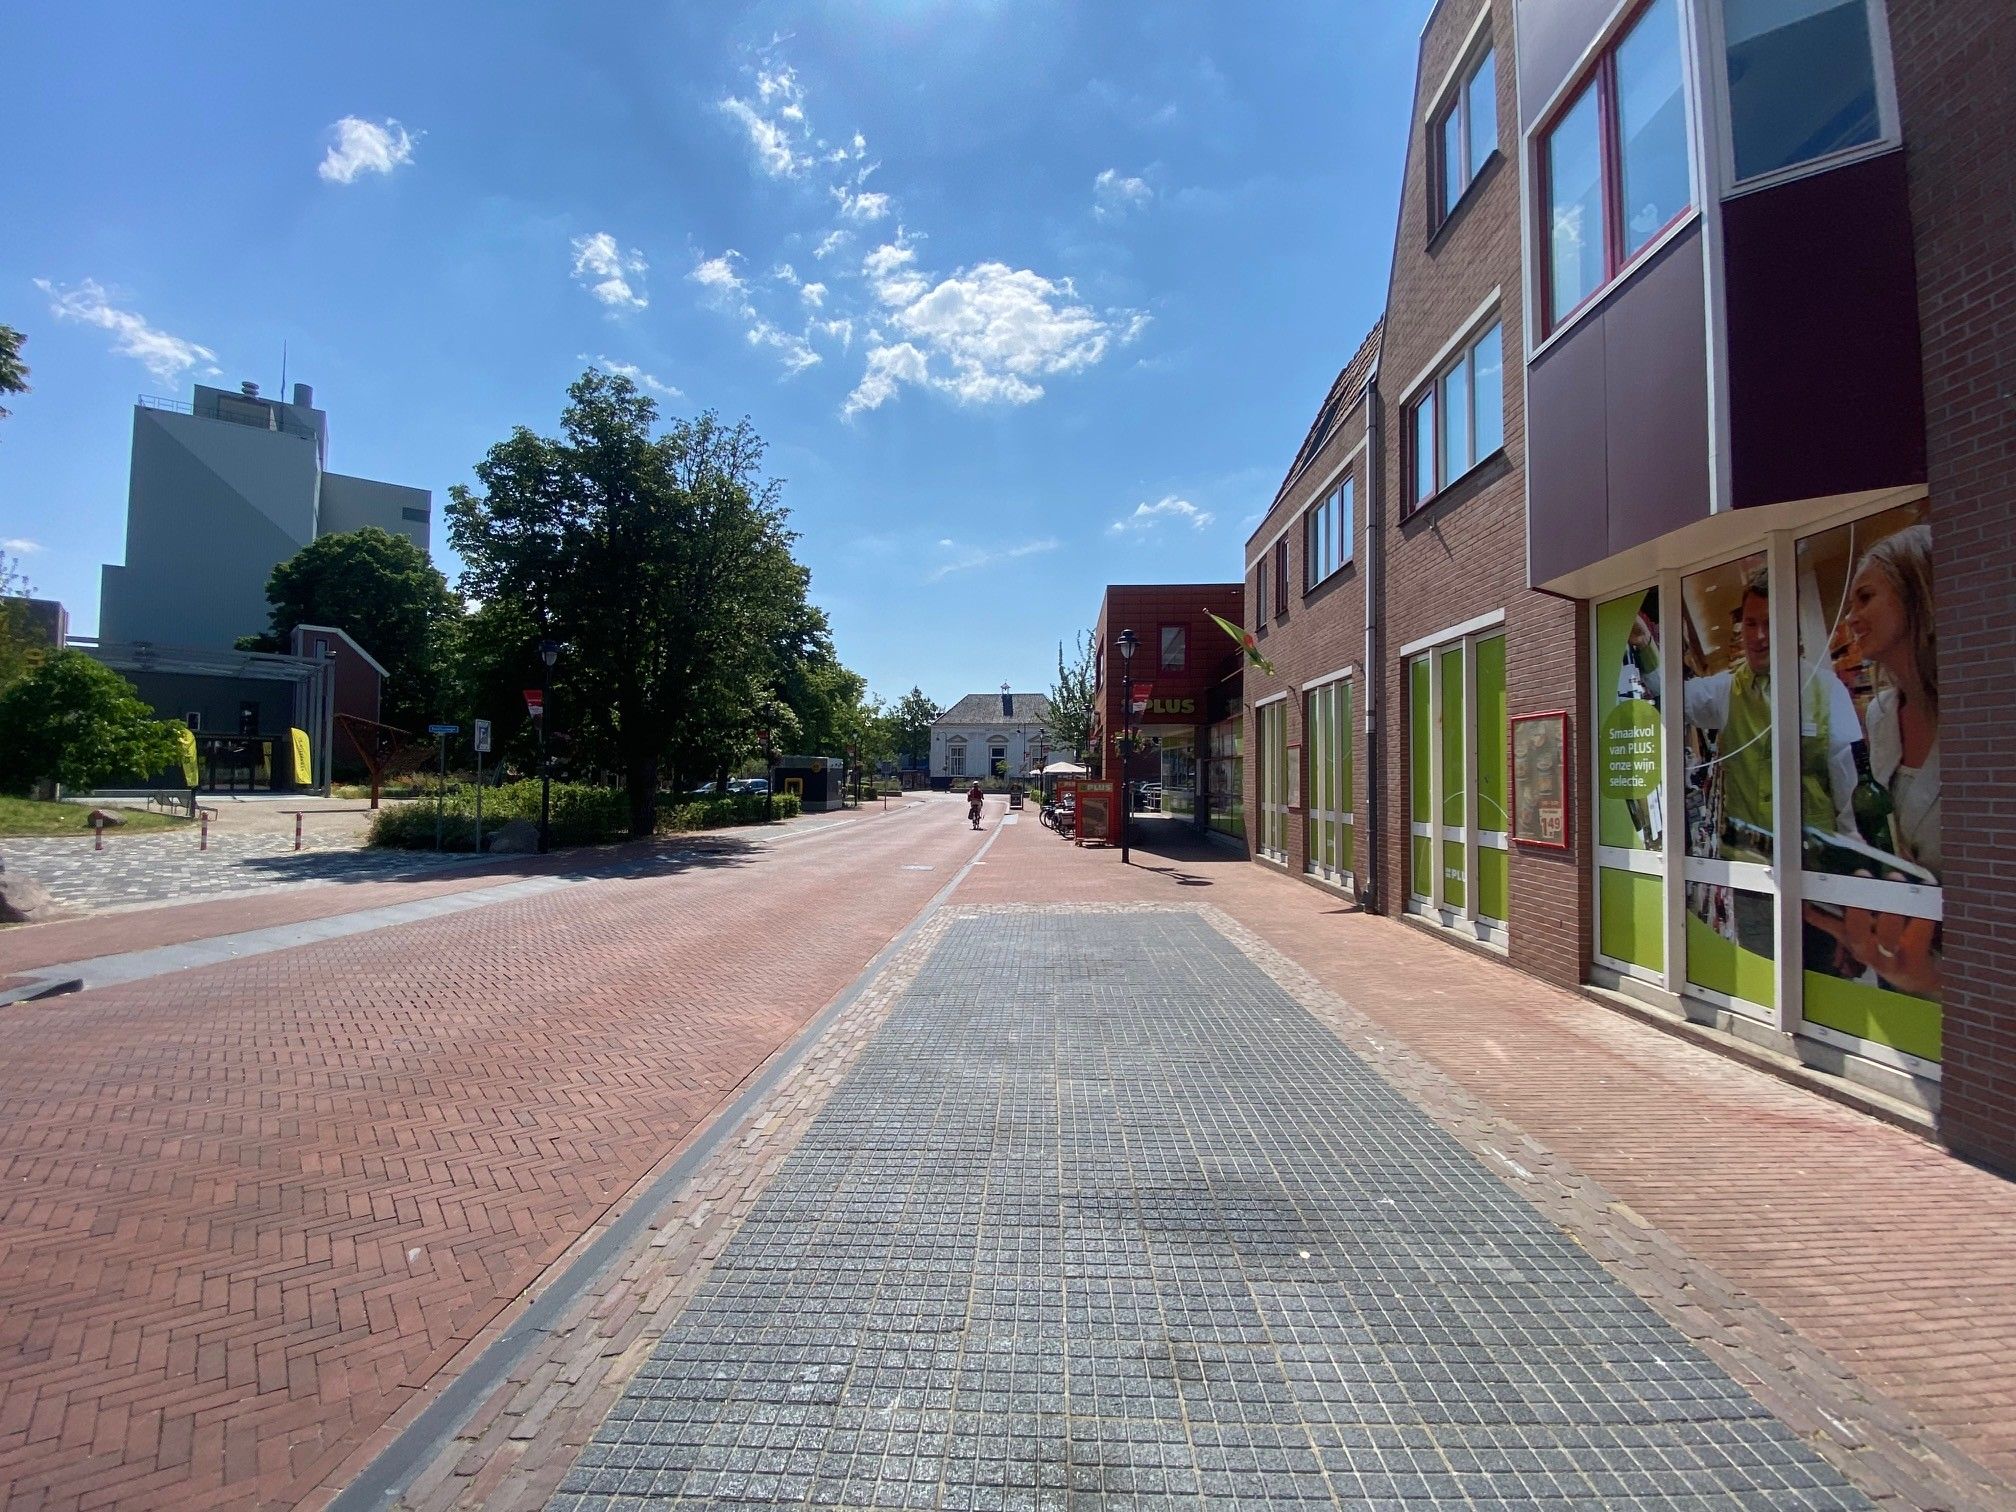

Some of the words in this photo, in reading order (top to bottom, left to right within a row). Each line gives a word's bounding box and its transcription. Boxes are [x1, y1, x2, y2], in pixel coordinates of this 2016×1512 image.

[1609, 724, 1655, 739] Smaakvol
[1609, 745, 1626, 755] van
[1628, 742, 1655, 754] PLUS:
[1609, 761, 1632, 771] onze
[1633, 758, 1655, 773] wijn
[1609, 775, 1647, 787] selectie.
